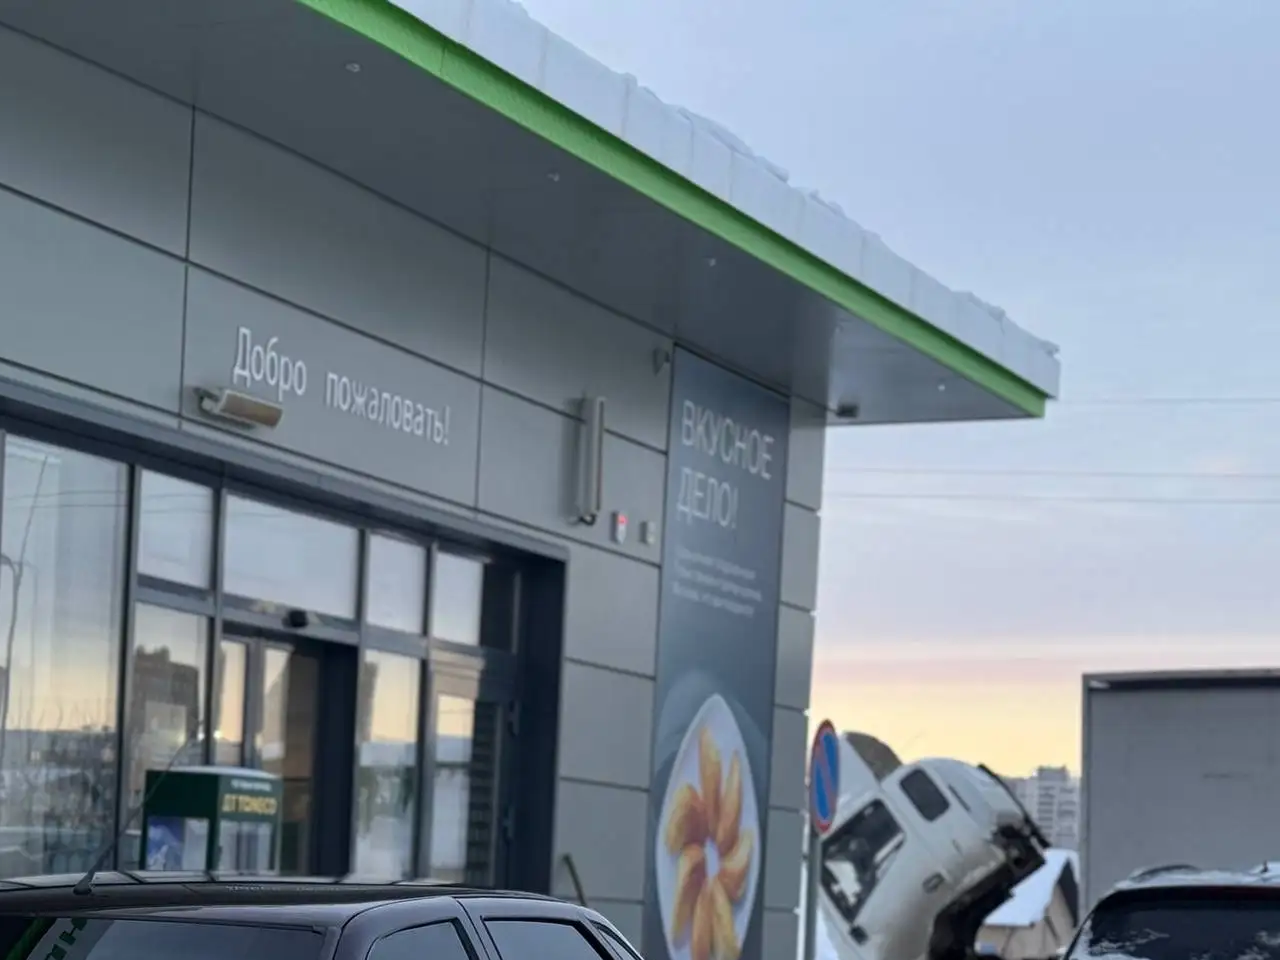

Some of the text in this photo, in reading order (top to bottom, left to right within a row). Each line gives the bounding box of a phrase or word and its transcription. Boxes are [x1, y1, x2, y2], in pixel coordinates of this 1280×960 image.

[233, 326, 451, 445] Добро пожаловать!
[682, 399, 775, 480] ВКУСНОЕ
[676, 466, 738, 529] ДЕЛО!
